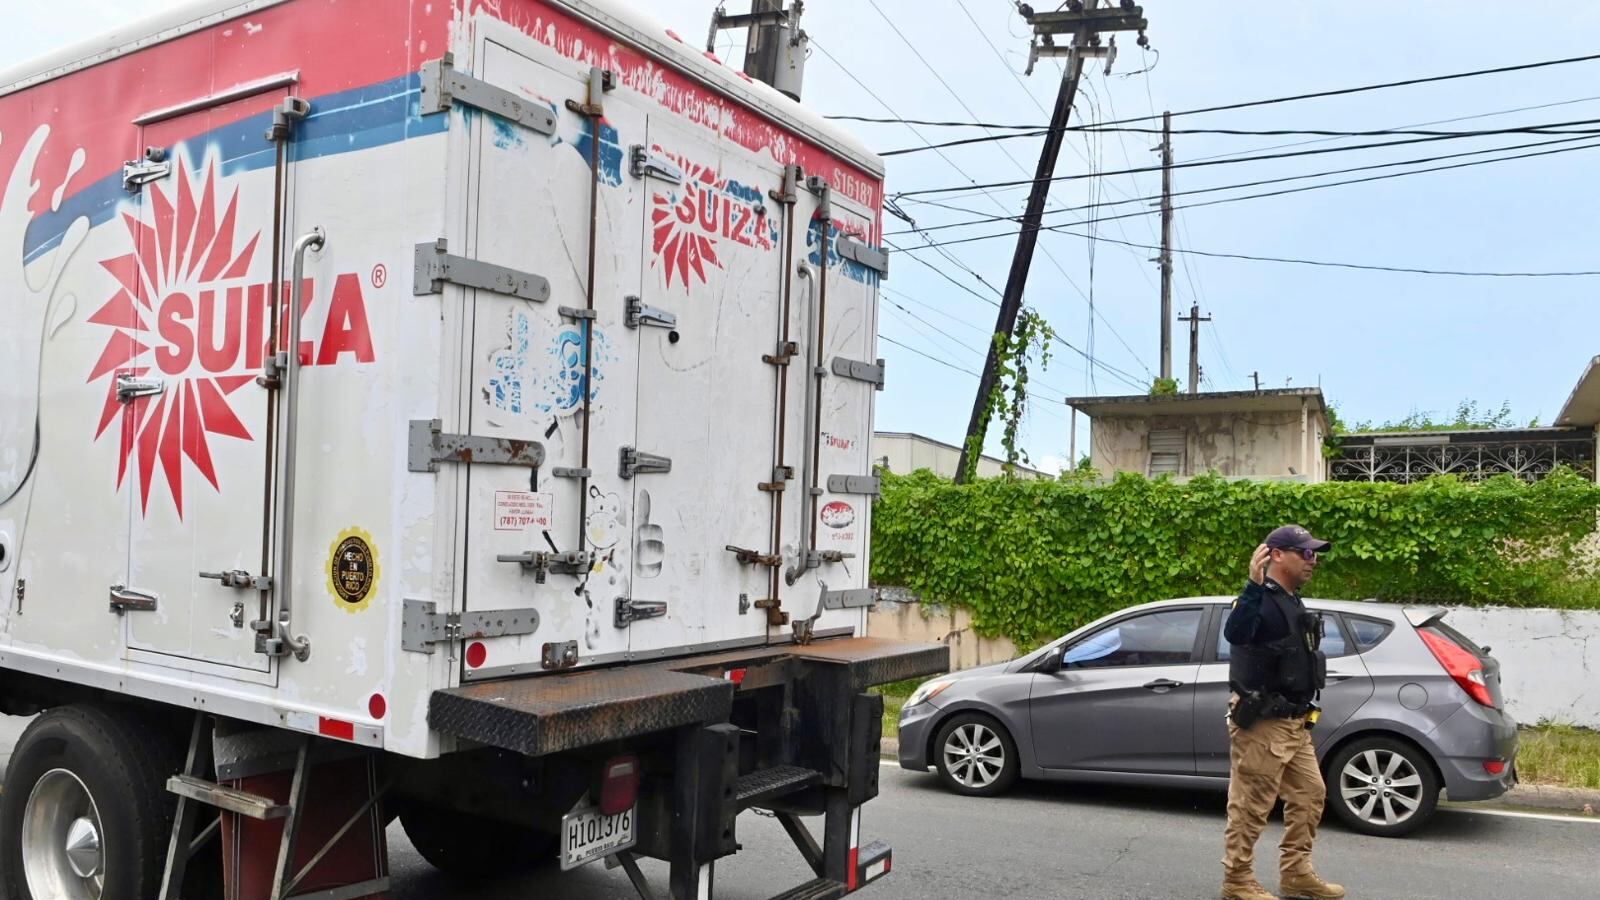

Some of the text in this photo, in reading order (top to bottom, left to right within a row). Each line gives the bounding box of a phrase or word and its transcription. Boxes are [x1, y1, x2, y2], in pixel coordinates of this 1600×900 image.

[675, 182, 770, 251] SUIZA
[154, 273, 376, 375] SUIZA
[500, 516, 517, 527] (787)
[344, 551, 364, 562] HECHO
[349, 562, 358, 571] EN
[341, 570, 365, 581] PUERTO
[345, 580, 360, 591] RICO
[569, 808, 630, 851] H101376
